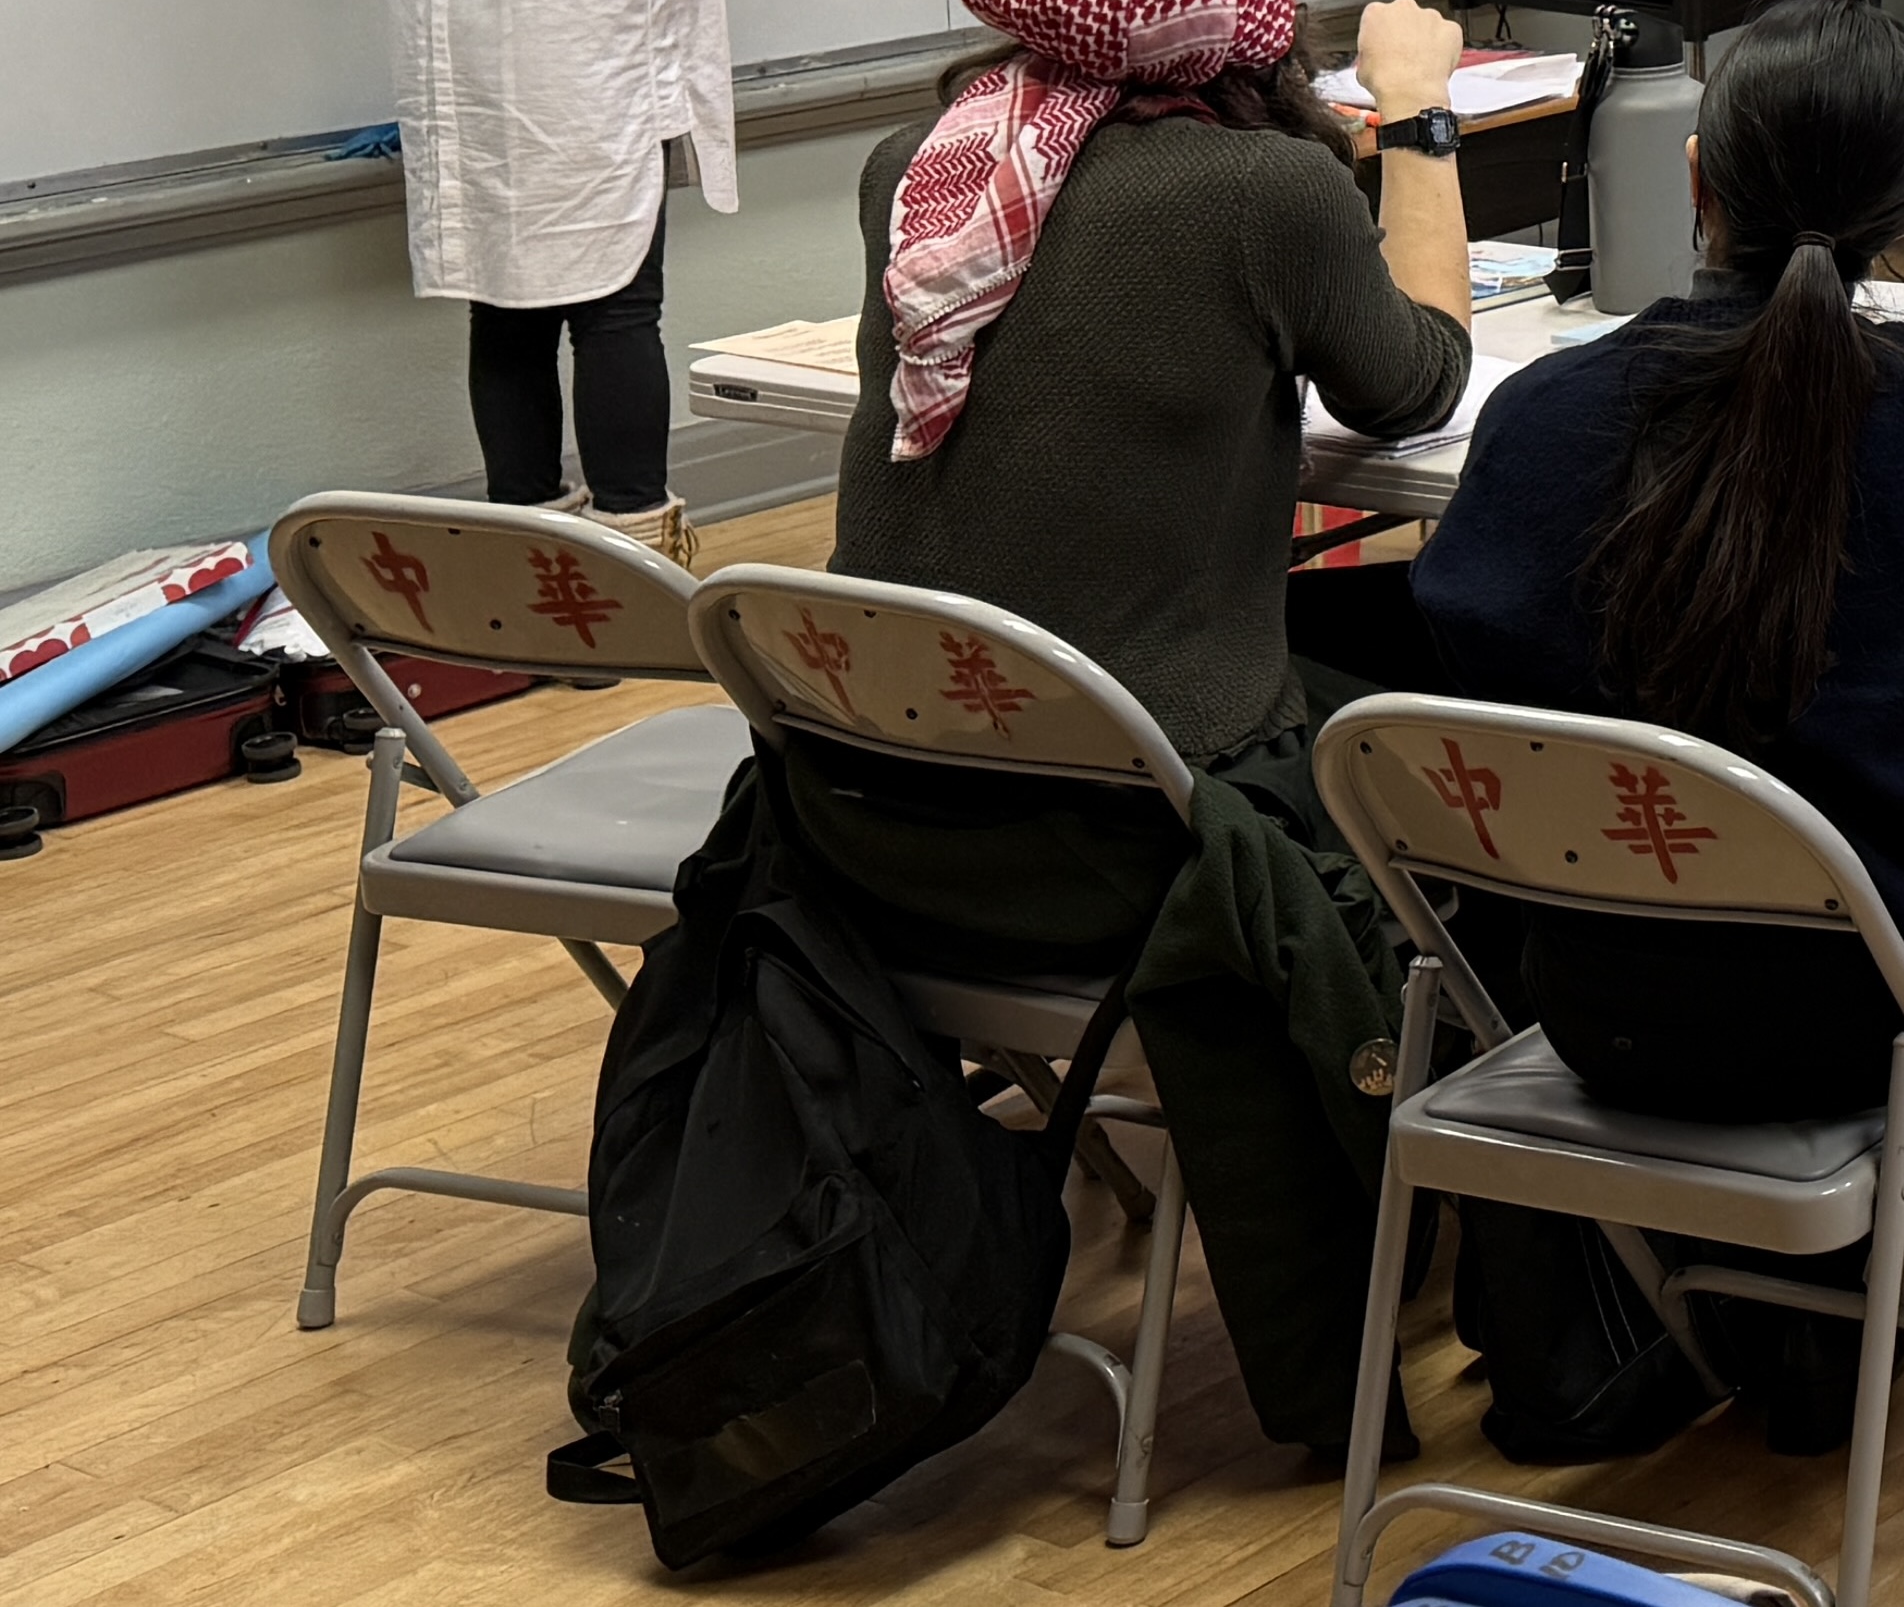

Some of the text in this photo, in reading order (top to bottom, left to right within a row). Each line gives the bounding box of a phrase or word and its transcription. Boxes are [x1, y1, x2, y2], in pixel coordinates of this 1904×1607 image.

[359, 530, 624, 650] 中華
[784, 605, 1038, 740] 中華
[1422, 737, 1719, 886] 中華
